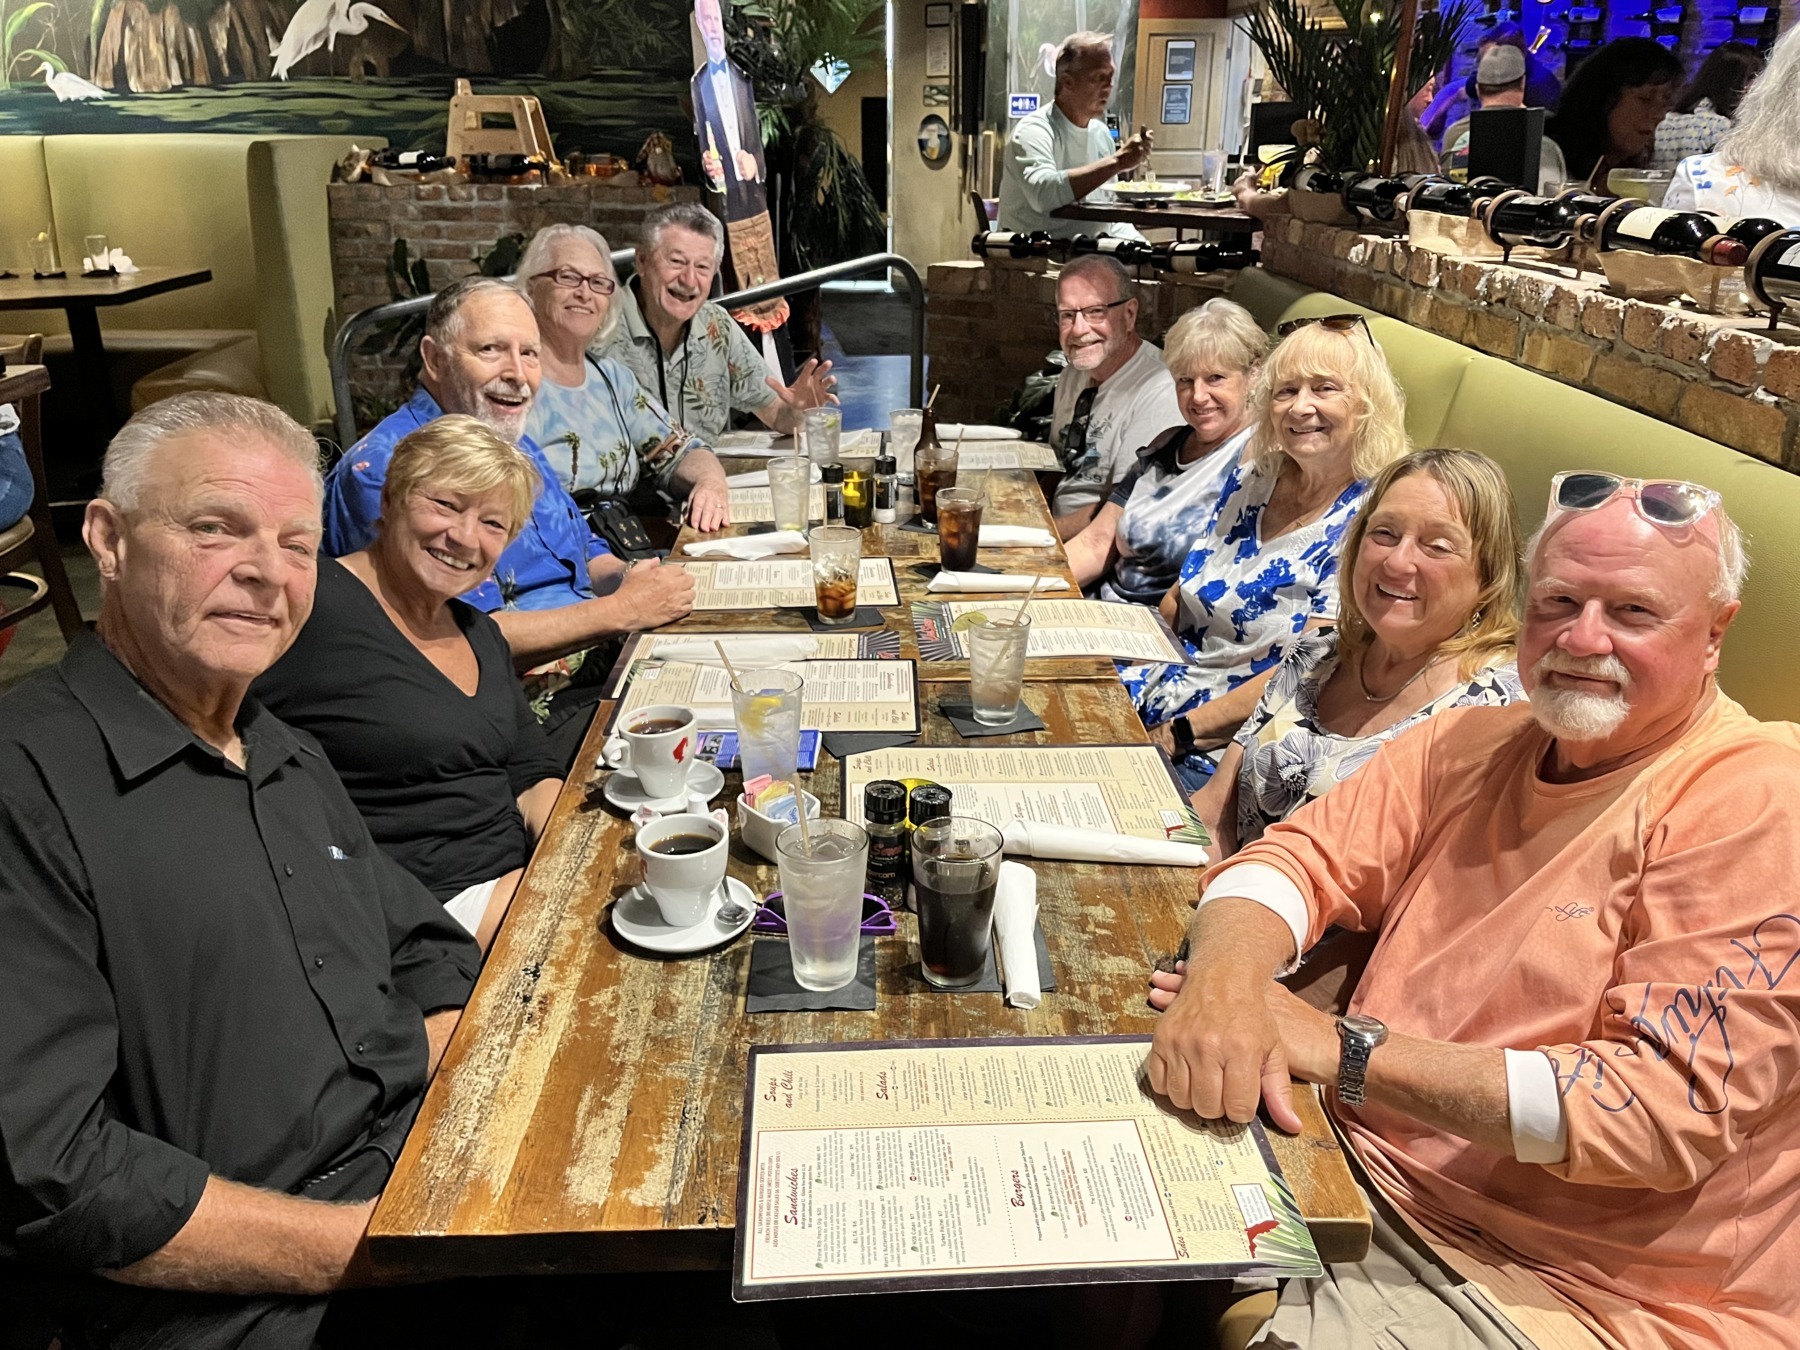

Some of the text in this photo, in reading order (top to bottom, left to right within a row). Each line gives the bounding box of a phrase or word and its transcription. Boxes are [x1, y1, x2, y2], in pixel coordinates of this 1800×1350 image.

[764, 1078, 779, 1101] Soups
[780, 1070, 793, 1108] and Chili
[876, 1071, 888, 1100] Salads
[784, 1168, 799, 1225] Sandwiches
[1010, 1170, 1026, 1207] Burgers
[1177, 1236, 1190, 1258] Sides
